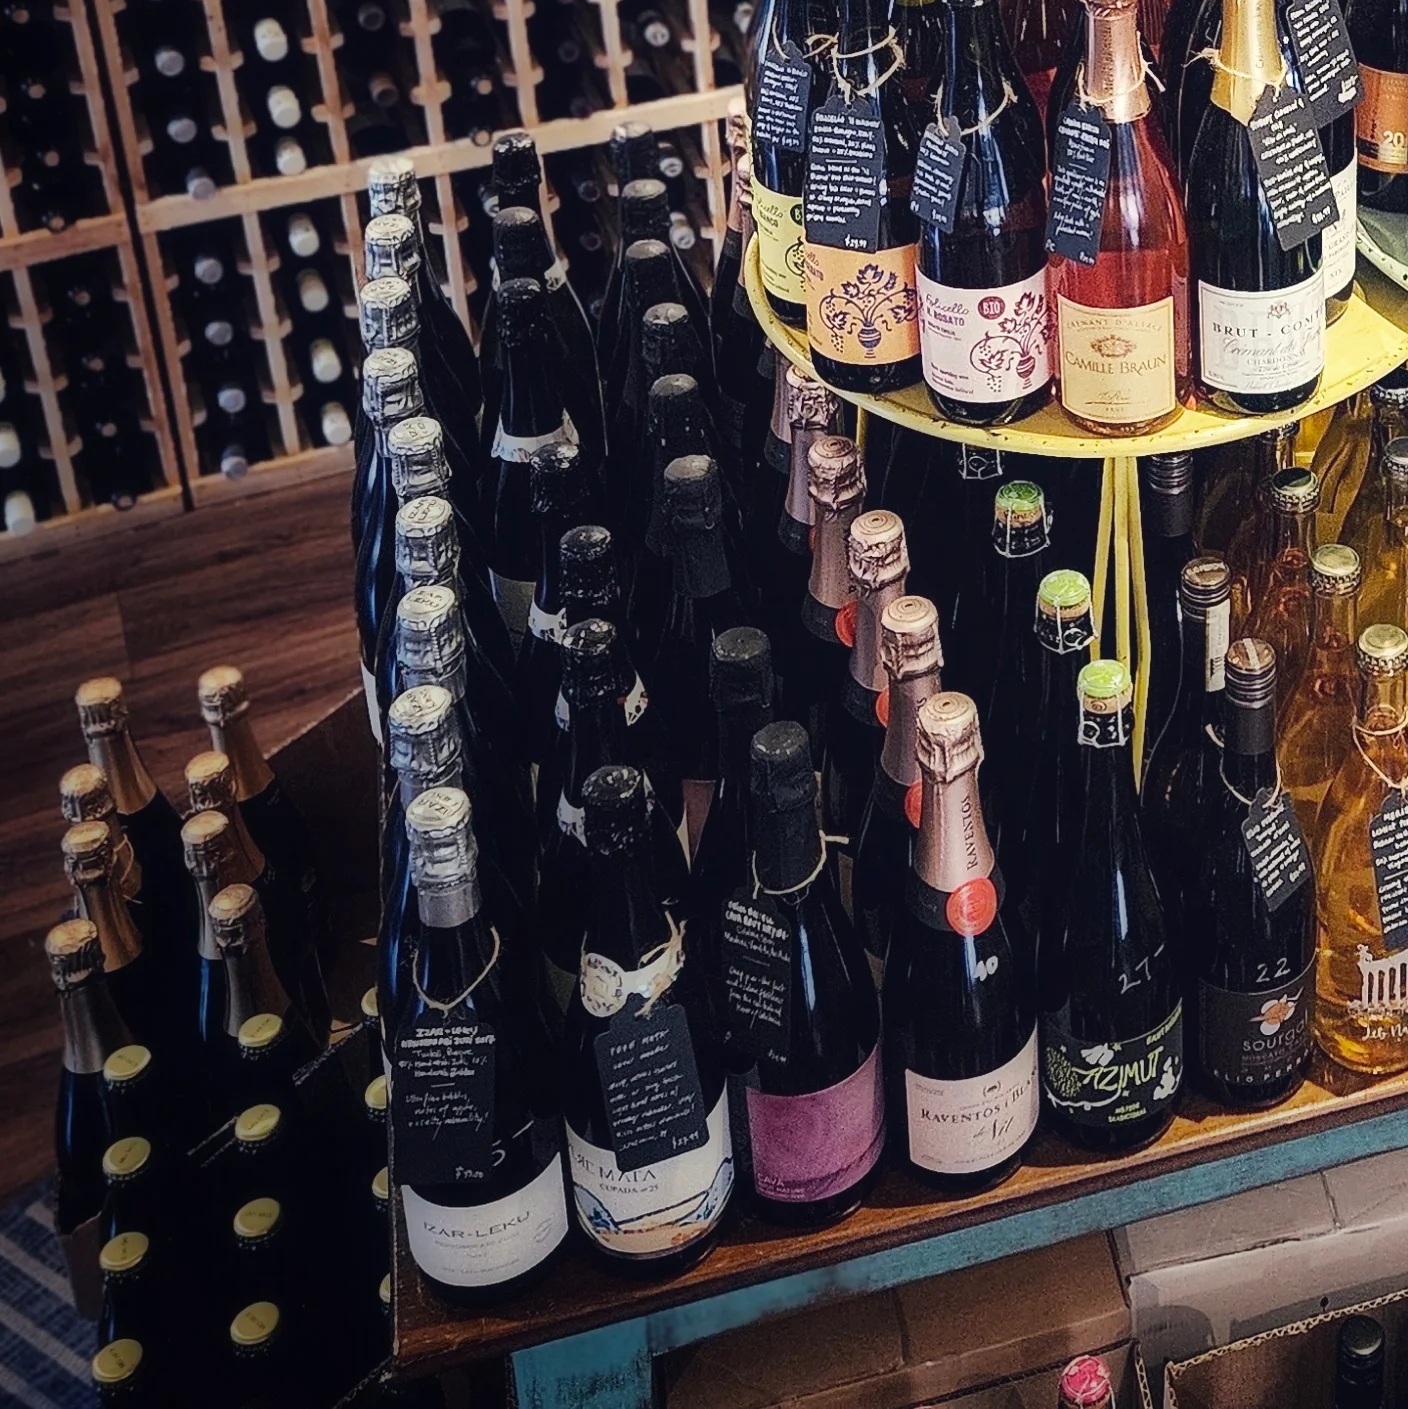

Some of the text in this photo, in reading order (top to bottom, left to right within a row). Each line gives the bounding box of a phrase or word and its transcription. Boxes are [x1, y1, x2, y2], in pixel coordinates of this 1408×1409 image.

[1383, 130, 1405, 147] 20
[982, 301, 1000, 315] BIO
[1213, 322, 1258, 339] BRUT
[1065, 351, 1166, 376] CAMILLE BRAUN
[1255, 957, 1291, 983] 22
[424, 1210, 530, 1238] IZAR-LEKU
